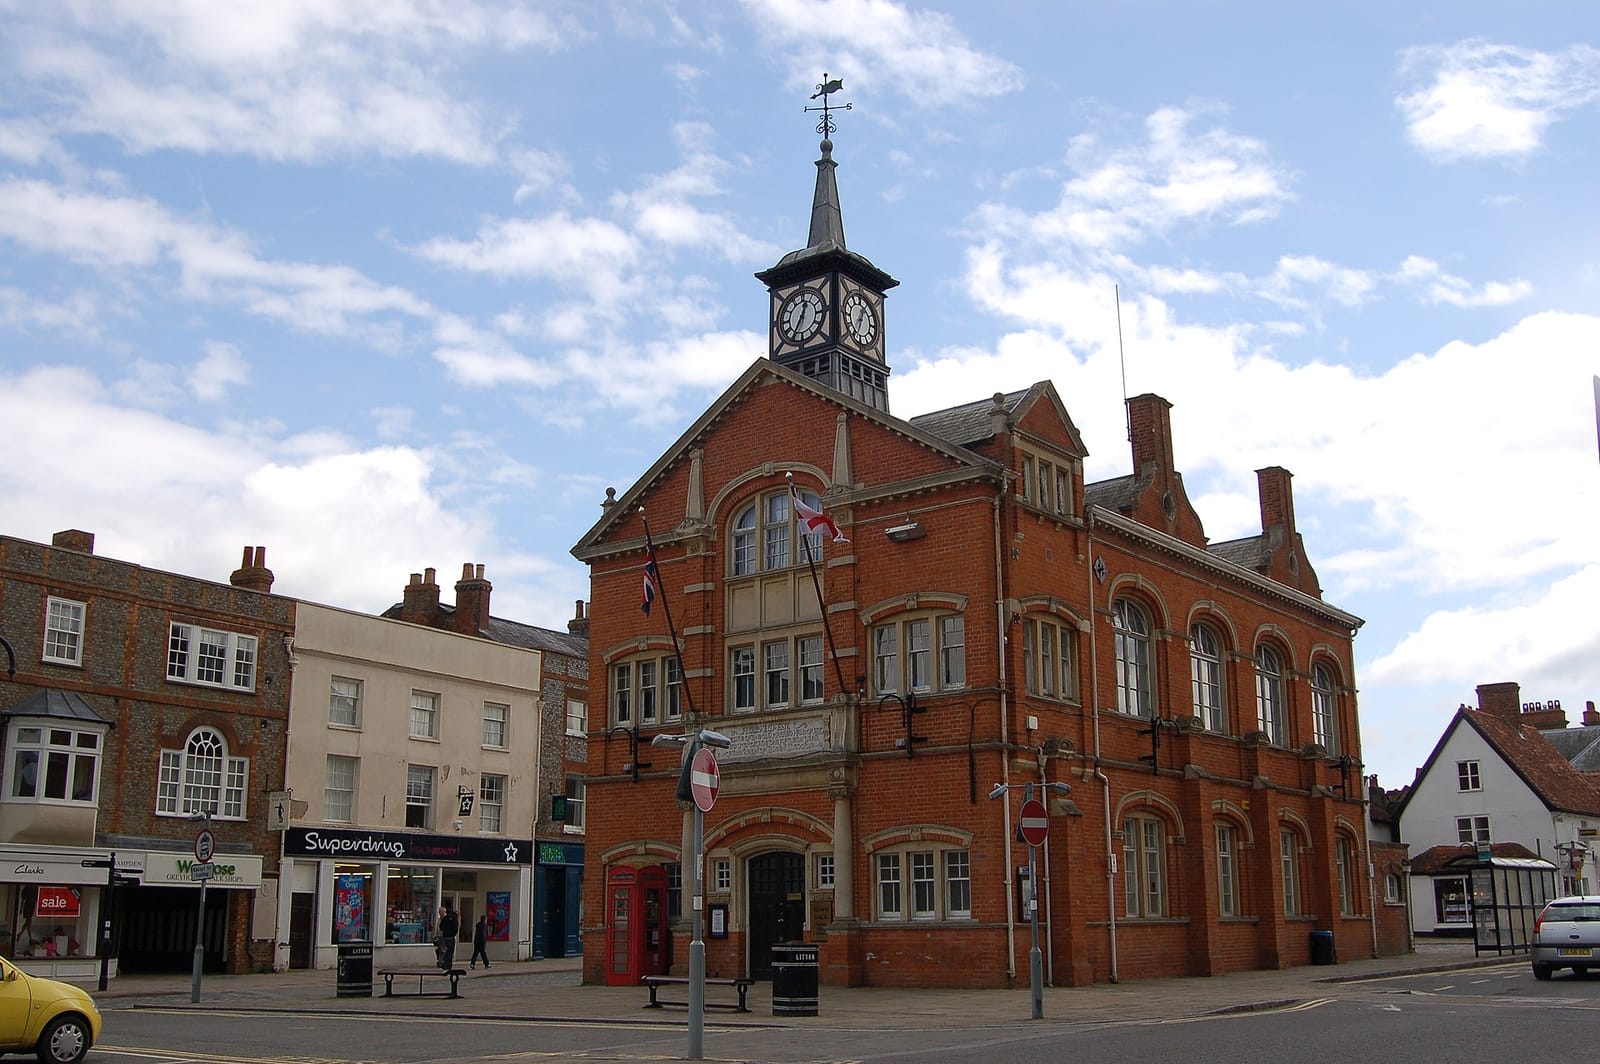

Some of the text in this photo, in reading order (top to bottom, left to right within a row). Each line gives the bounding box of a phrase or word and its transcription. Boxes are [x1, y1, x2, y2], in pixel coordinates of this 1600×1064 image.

[305, 832, 405, 858] Superdrug
[15, 864, 44, 874] Clarks
[41, 896, 67, 908] sale
[795, 953, 815, 961] LITTER
